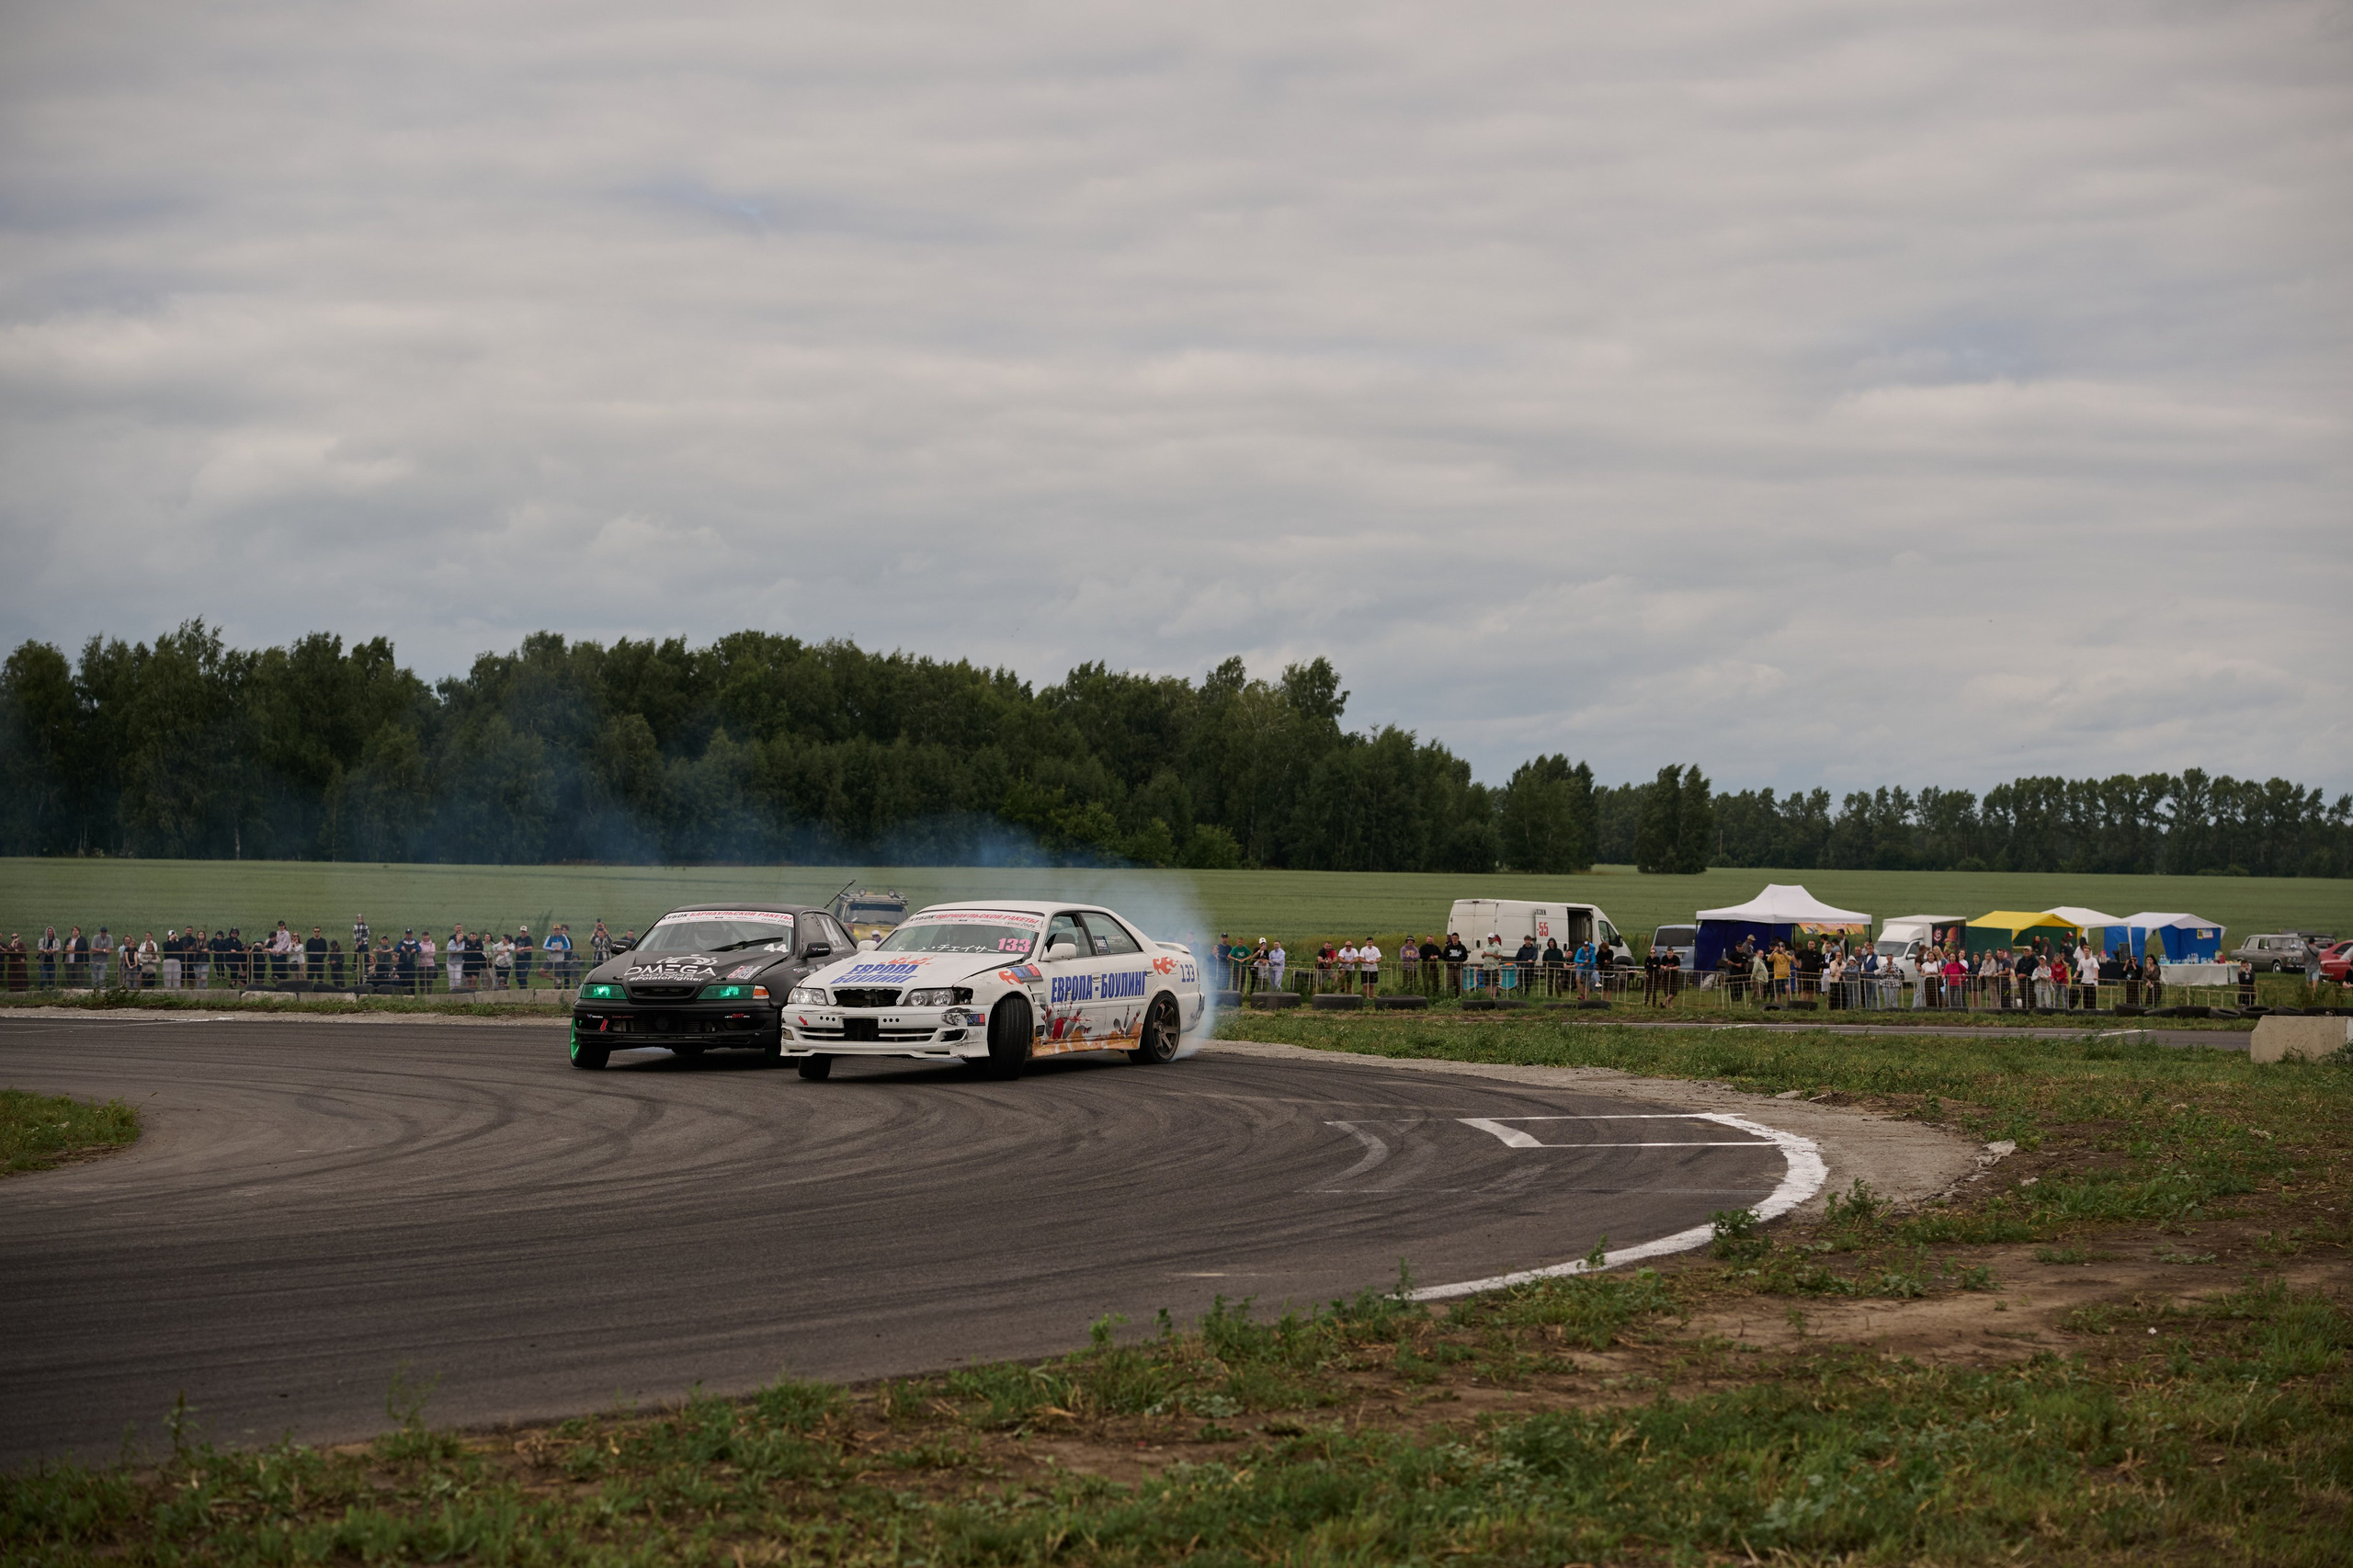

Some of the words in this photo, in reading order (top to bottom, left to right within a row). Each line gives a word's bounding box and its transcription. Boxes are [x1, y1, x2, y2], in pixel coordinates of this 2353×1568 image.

[662, 913, 688, 921] КУБОК
[758, 912, 793, 920] РАКЕТЫ
[1004, 915, 1039, 925] РАКЕТЫ
[1537, 921, 1549, 937] -55
[764, 943, 789, 953] 44
[997, 937, 1031, 953] 133
[624, 964, 716, 977] OMEGA
[846, 964, 919, 974] ЕВРОПА
[1180, 964, 1195, 983] 133
[830, 974, 918, 984] БОУЛИНГ
[1051, 974, 1093, 1004] ЕВРОПА
[1100, 971, 1148, 999] БОУЛИНГ
